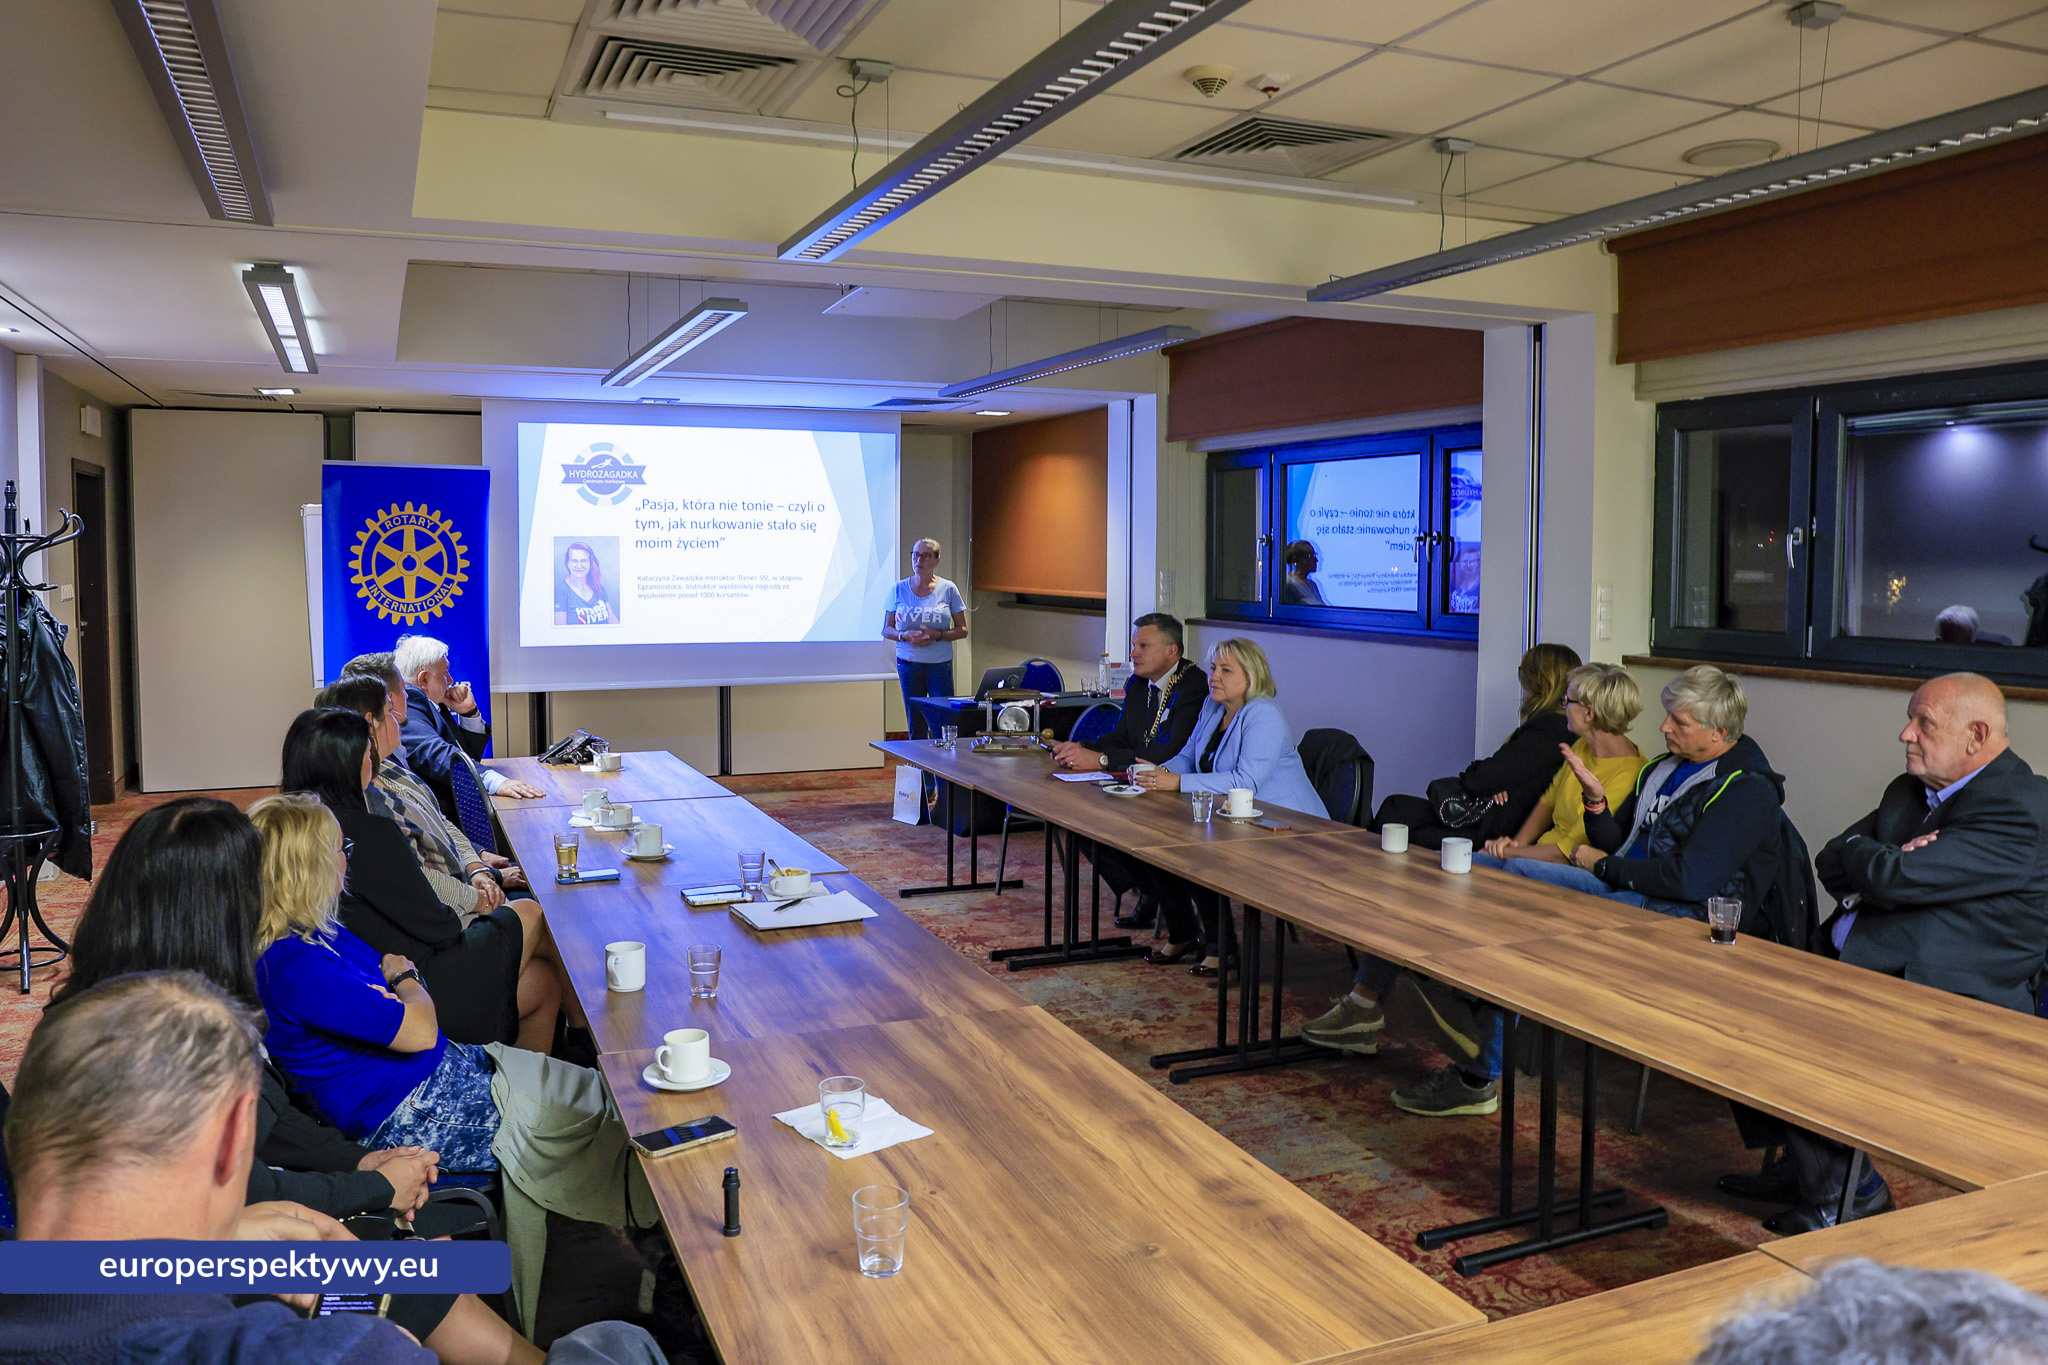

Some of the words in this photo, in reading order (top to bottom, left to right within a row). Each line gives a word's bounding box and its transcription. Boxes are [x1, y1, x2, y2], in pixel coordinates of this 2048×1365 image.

[569, 470, 638, 479] HYDROZAGADKA
[635, 499, 678, 512] „Pasja,
[683, 499, 715, 511] która
[719, 500, 738, 511] nie
[742, 500, 773, 511] tonie
[788, 501, 814, 514] czyli
[817, 504, 825, 512] o
[385, 515, 434, 530] ROTARY
[635, 519, 664, 531] tym,
[668, 518, 686, 531] jak
[690, 518, 763, 530] nurkowanie
[767, 519, 797, 531] stało
[800, 520, 817, 533] się
[635, 537, 672, 548] moim
[677, 537, 725, 551] życiem”
[369, 582, 453, 613] INTERNATIONAL
